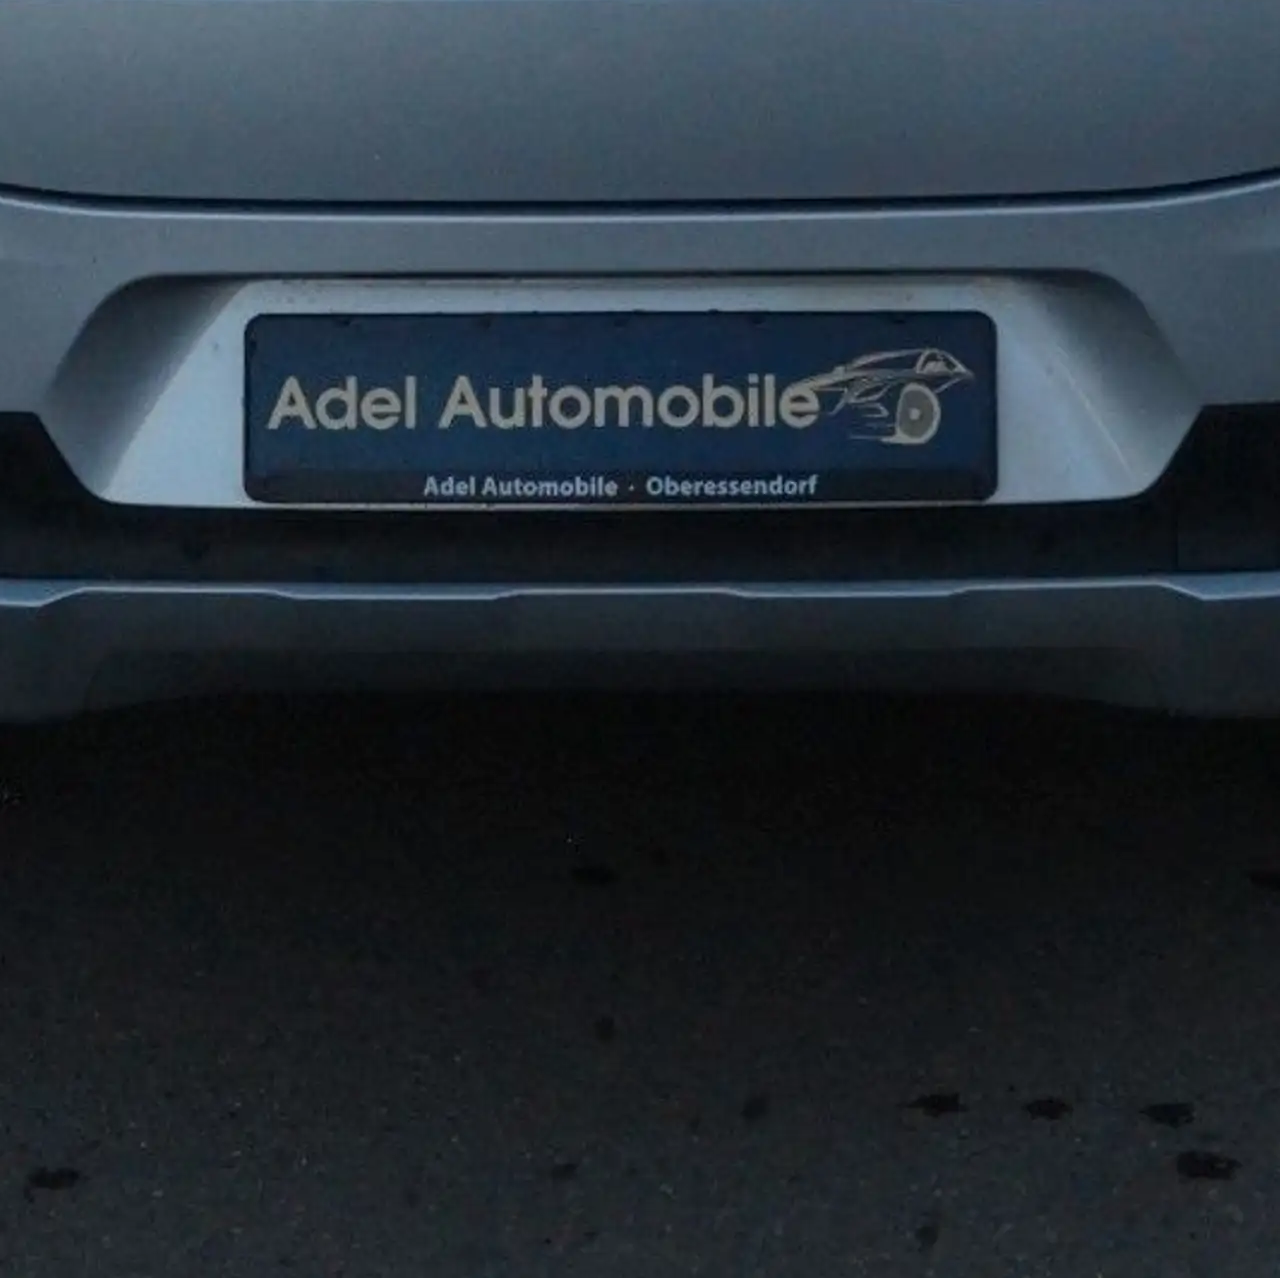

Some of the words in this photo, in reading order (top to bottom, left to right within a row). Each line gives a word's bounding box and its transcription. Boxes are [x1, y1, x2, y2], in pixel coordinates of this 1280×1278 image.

[268, 375, 417, 430] Adel
[438, 374, 820, 430] Automobile
[424, 476, 476, 496] Adel
[482, 476, 619, 497] Automobile
[646, 474, 819, 496] Oberessendorf
